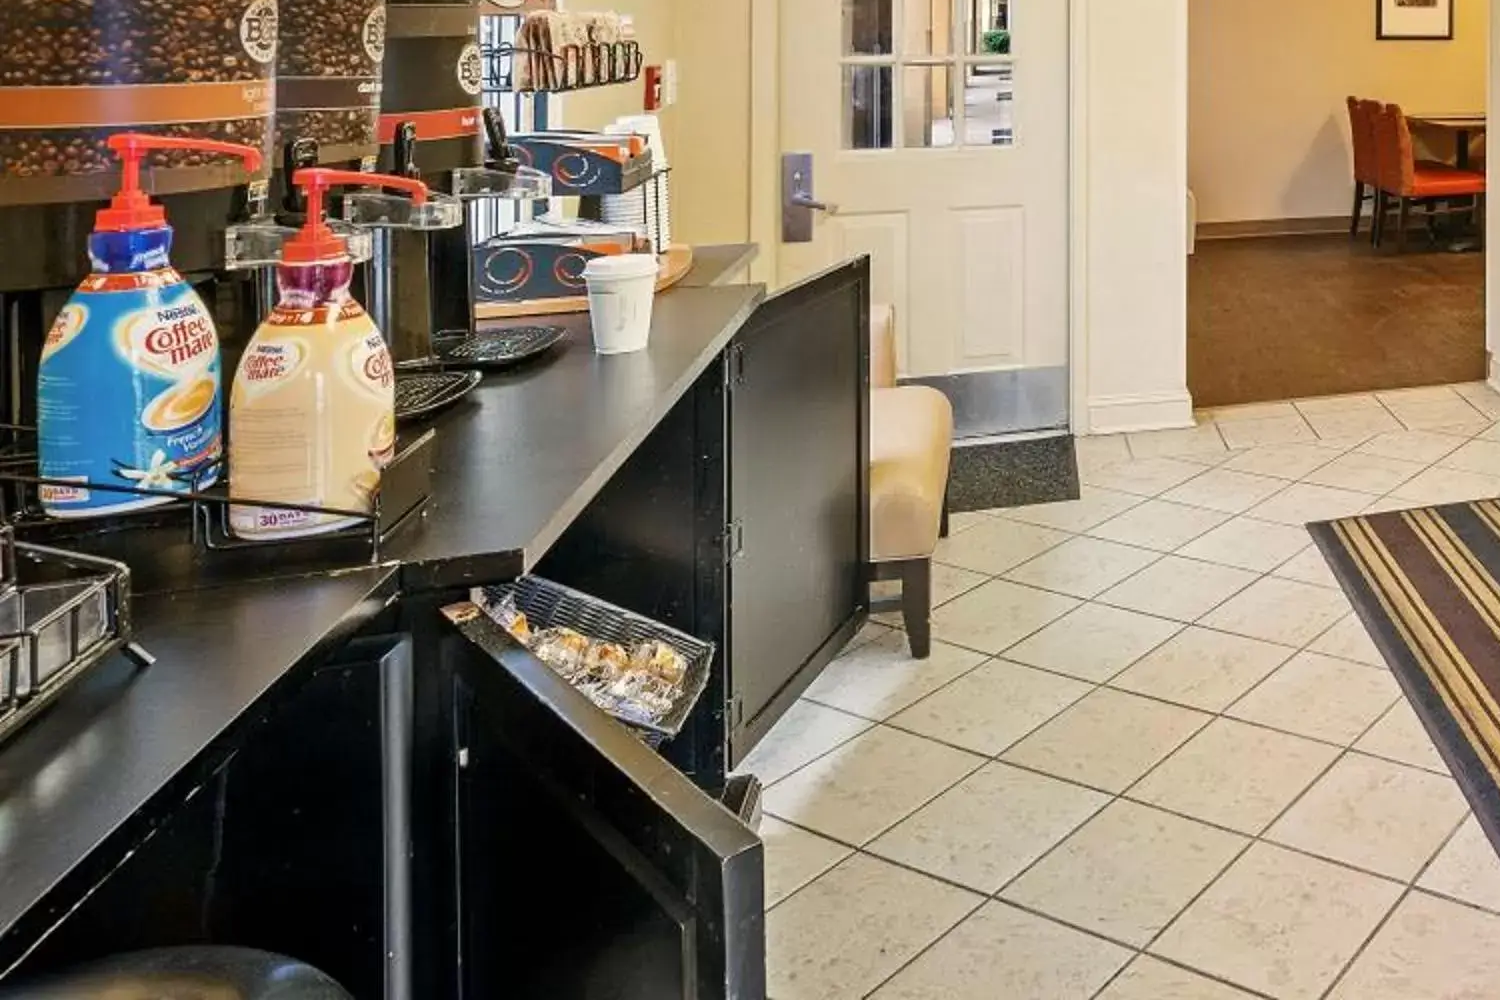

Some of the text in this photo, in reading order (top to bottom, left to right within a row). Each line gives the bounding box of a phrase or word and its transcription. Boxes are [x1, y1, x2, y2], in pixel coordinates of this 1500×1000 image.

[145, 316, 207, 354] Coffee
[170, 331, 213, 365] mate
[259, 514, 278, 527] 30
